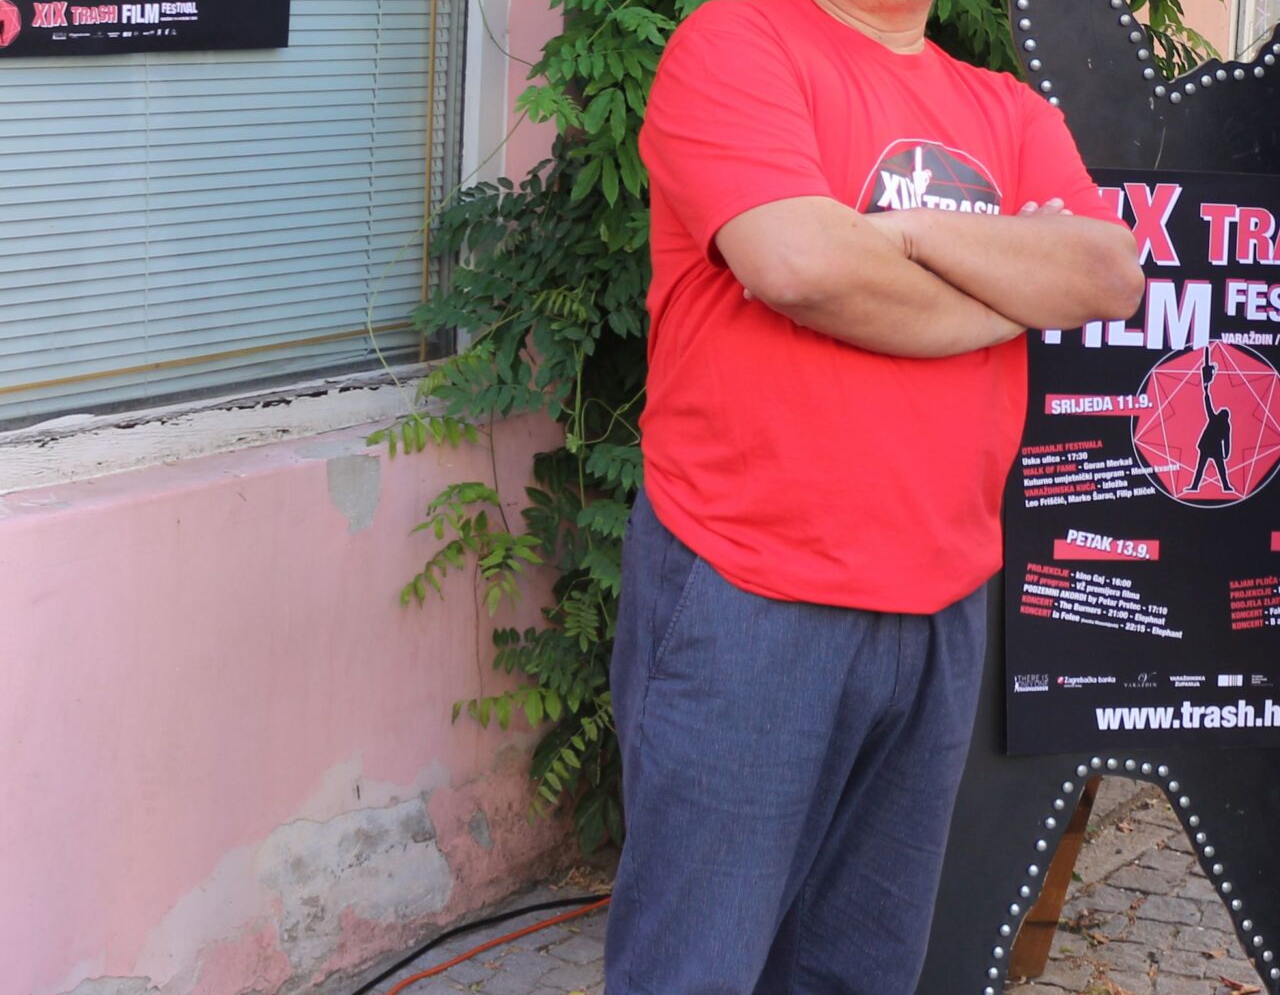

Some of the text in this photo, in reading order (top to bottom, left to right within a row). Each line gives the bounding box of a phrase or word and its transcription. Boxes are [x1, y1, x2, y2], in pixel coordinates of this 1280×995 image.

[32, 1, 198, 28] XIX TRASH FILM FESTIVAL
[1221, 331, 1272, 346] VARAŽDIN
[1051, 394, 1152, 414] SRIJEDA 11.9.
[1022, 440, 1103, 455] OTVARANJE FESTIVALA
[1022, 452, 1088, 466] Uska ulica 17:30
[1023, 466, 1044, 476] WALK
[1084, 461, 1106, 470] Goran
[1094, 470, 1124, 482] program
[1068, 494, 1092, 504] Marko
[1067, 529, 1150, 560] PETAK 13.9.
[1027, 563, 1070, 577] PROJEKCIJE
[1076, 571, 1092, 582] kino
[1093, 573, 1105, 584] Gaj
[1024, 584, 1060, 597] PODZEMNI
[1060, 590, 1087, 602] AKORDI
[1088, 593, 1097, 604] by
[1086, 584, 1120, 598] premijera
[1022, 595, 1053, 607] KONCERT
[1060, 600, 1072, 610] The
[1108, 609, 1128, 620] 21:00
[1232, 609, 1263, 620] KONCERT
[1020, 606, 1052, 618] KONCERT
[1152, 626, 1182, 639] Elephant
[1232, 619, 1264, 630] KONCERT
